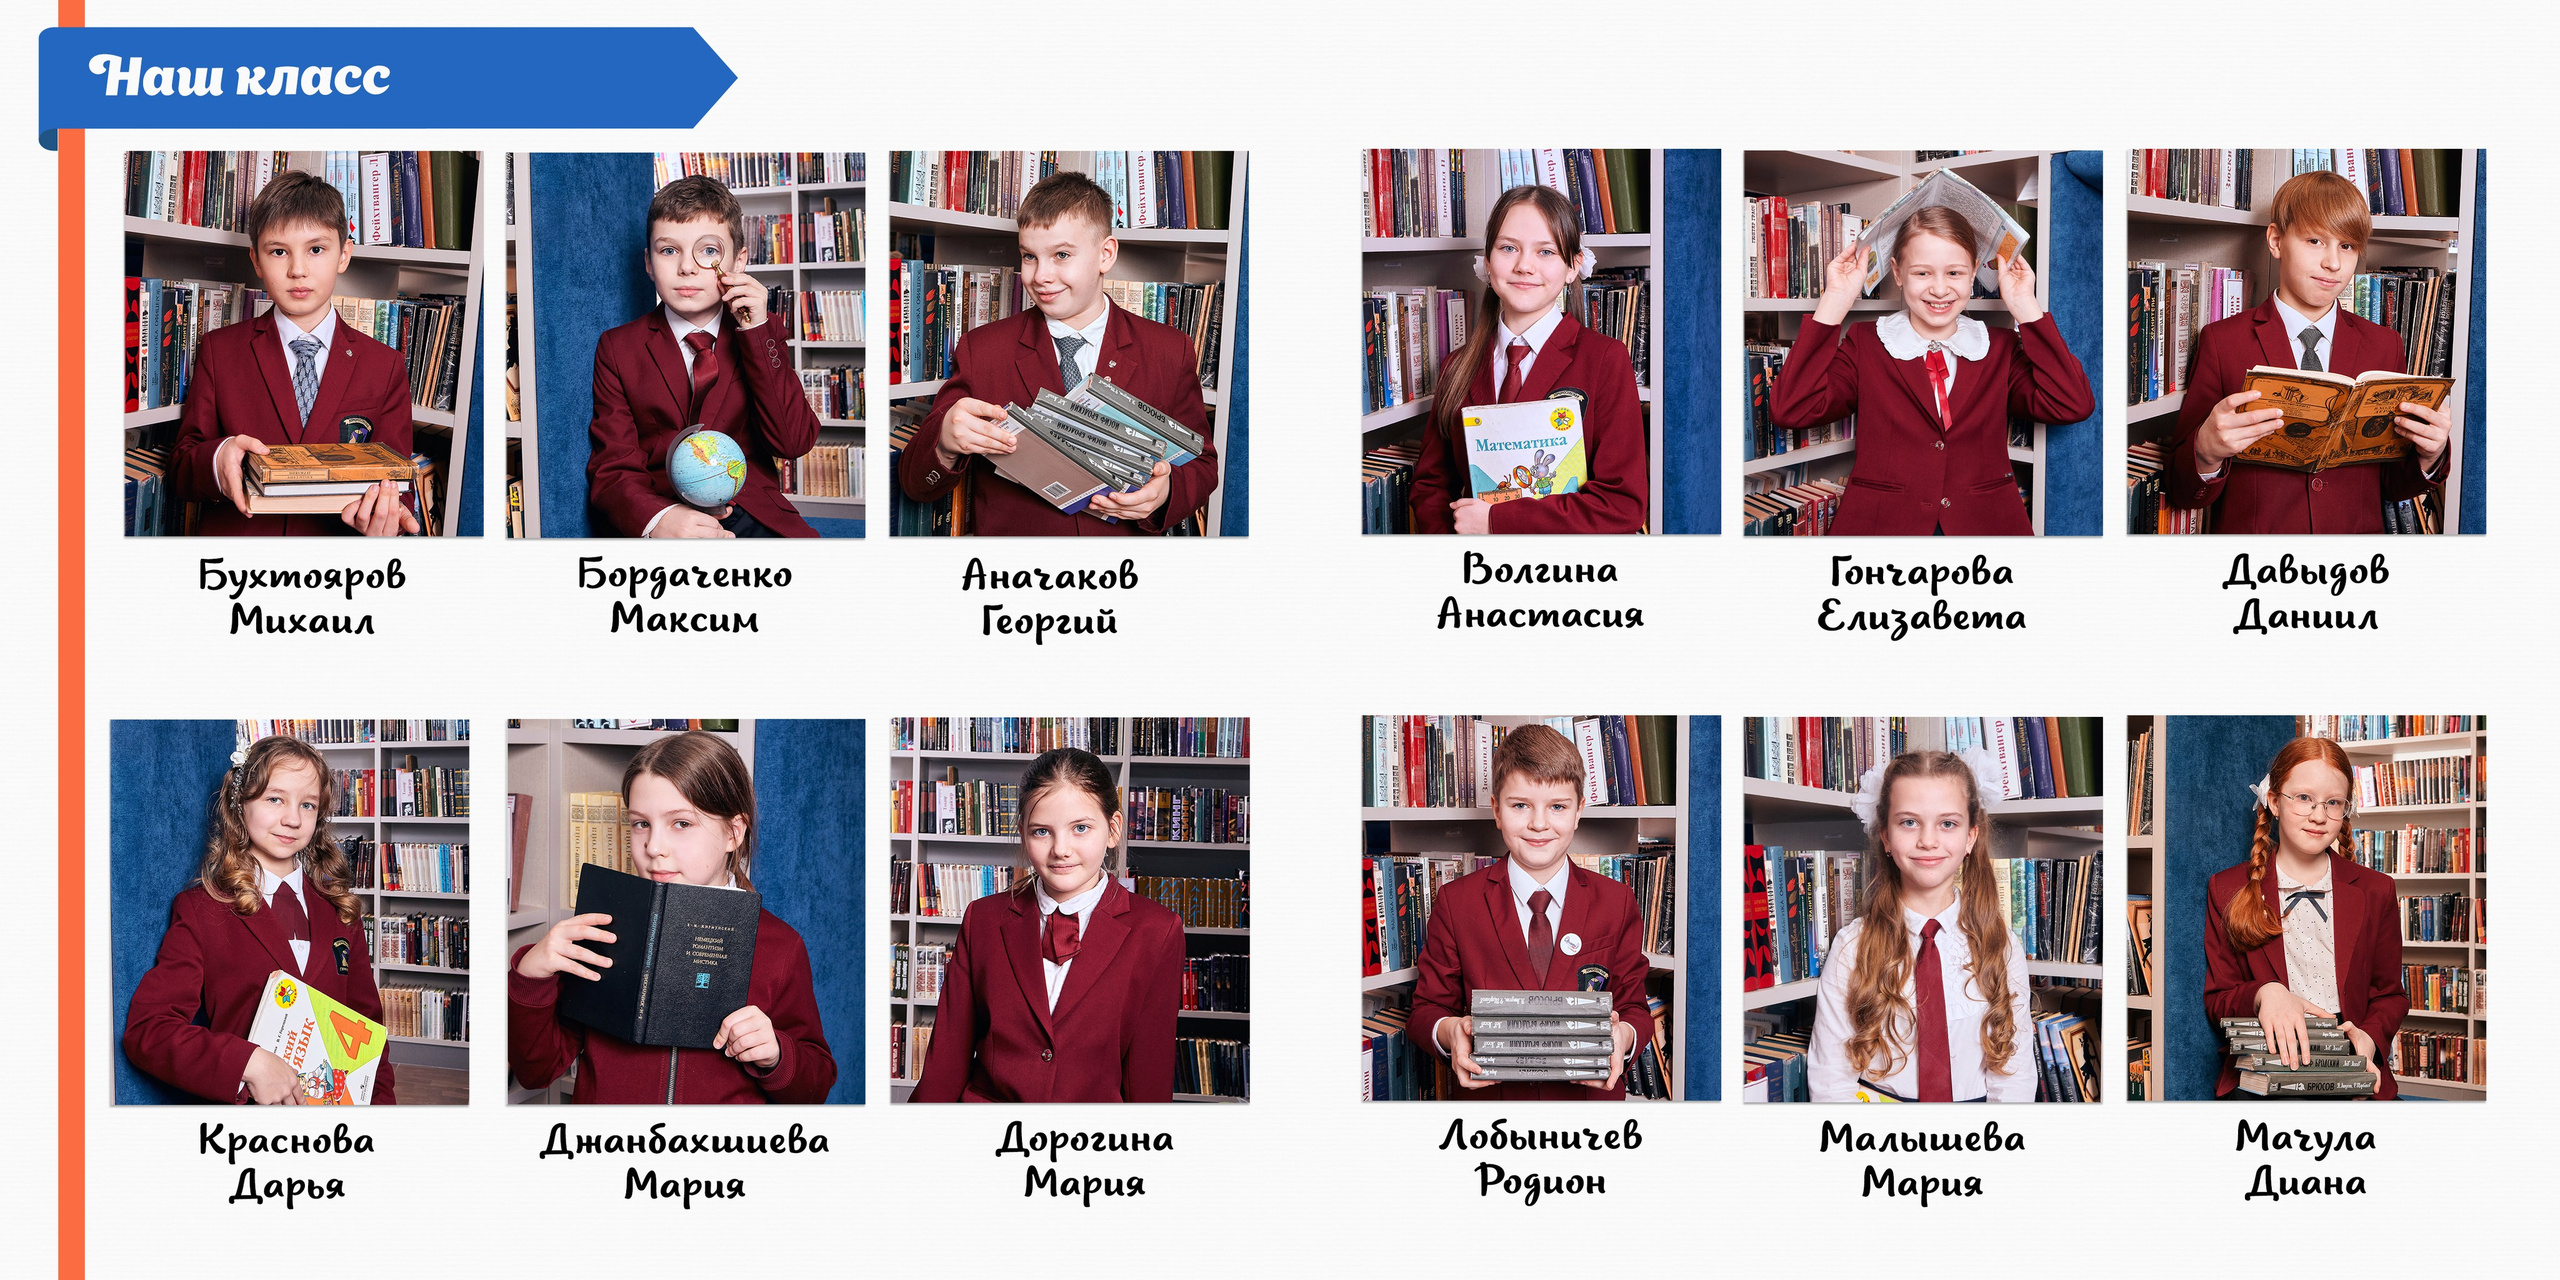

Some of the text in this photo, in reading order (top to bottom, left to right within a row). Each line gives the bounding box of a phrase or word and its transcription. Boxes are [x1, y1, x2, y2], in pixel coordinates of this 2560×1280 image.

[1137, 156, 1146, 224] Фейхтвангер
[371, 170, 381, 241] Фейхтвангер
[1070, 402, 1099, 422] БРОДСКИЙ
[1138, 401, 1166, 423] БРЮСОВ
[1056, 421, 1086, 440] БРОДСКИЙ
[1475, 435, 1568, 452] Математика
[1585, 736, 1598, 802] Фейхтвангер
[1172, 794, 1181, 841] КИНГ
[1181, 795, 1189, 841] КИНГ
[692, 944, 724, 952] РОМАНТИЗМ
[694, 936, 724, 944] НЕМЕЦКИЙ
[692, 951, 728, 959] СОВРЕМЕННАЯ
[927, 971, 936, 993] ИРВИНГ
[292, 1017, 316, 1069] ЯЗЫК
[329, 1010, 373, 1061] 4
[2314, 1058, 2339, 1068] БРОДСКИЙ
[2306, 1081, 2335, 1091] БРЮСОВ
